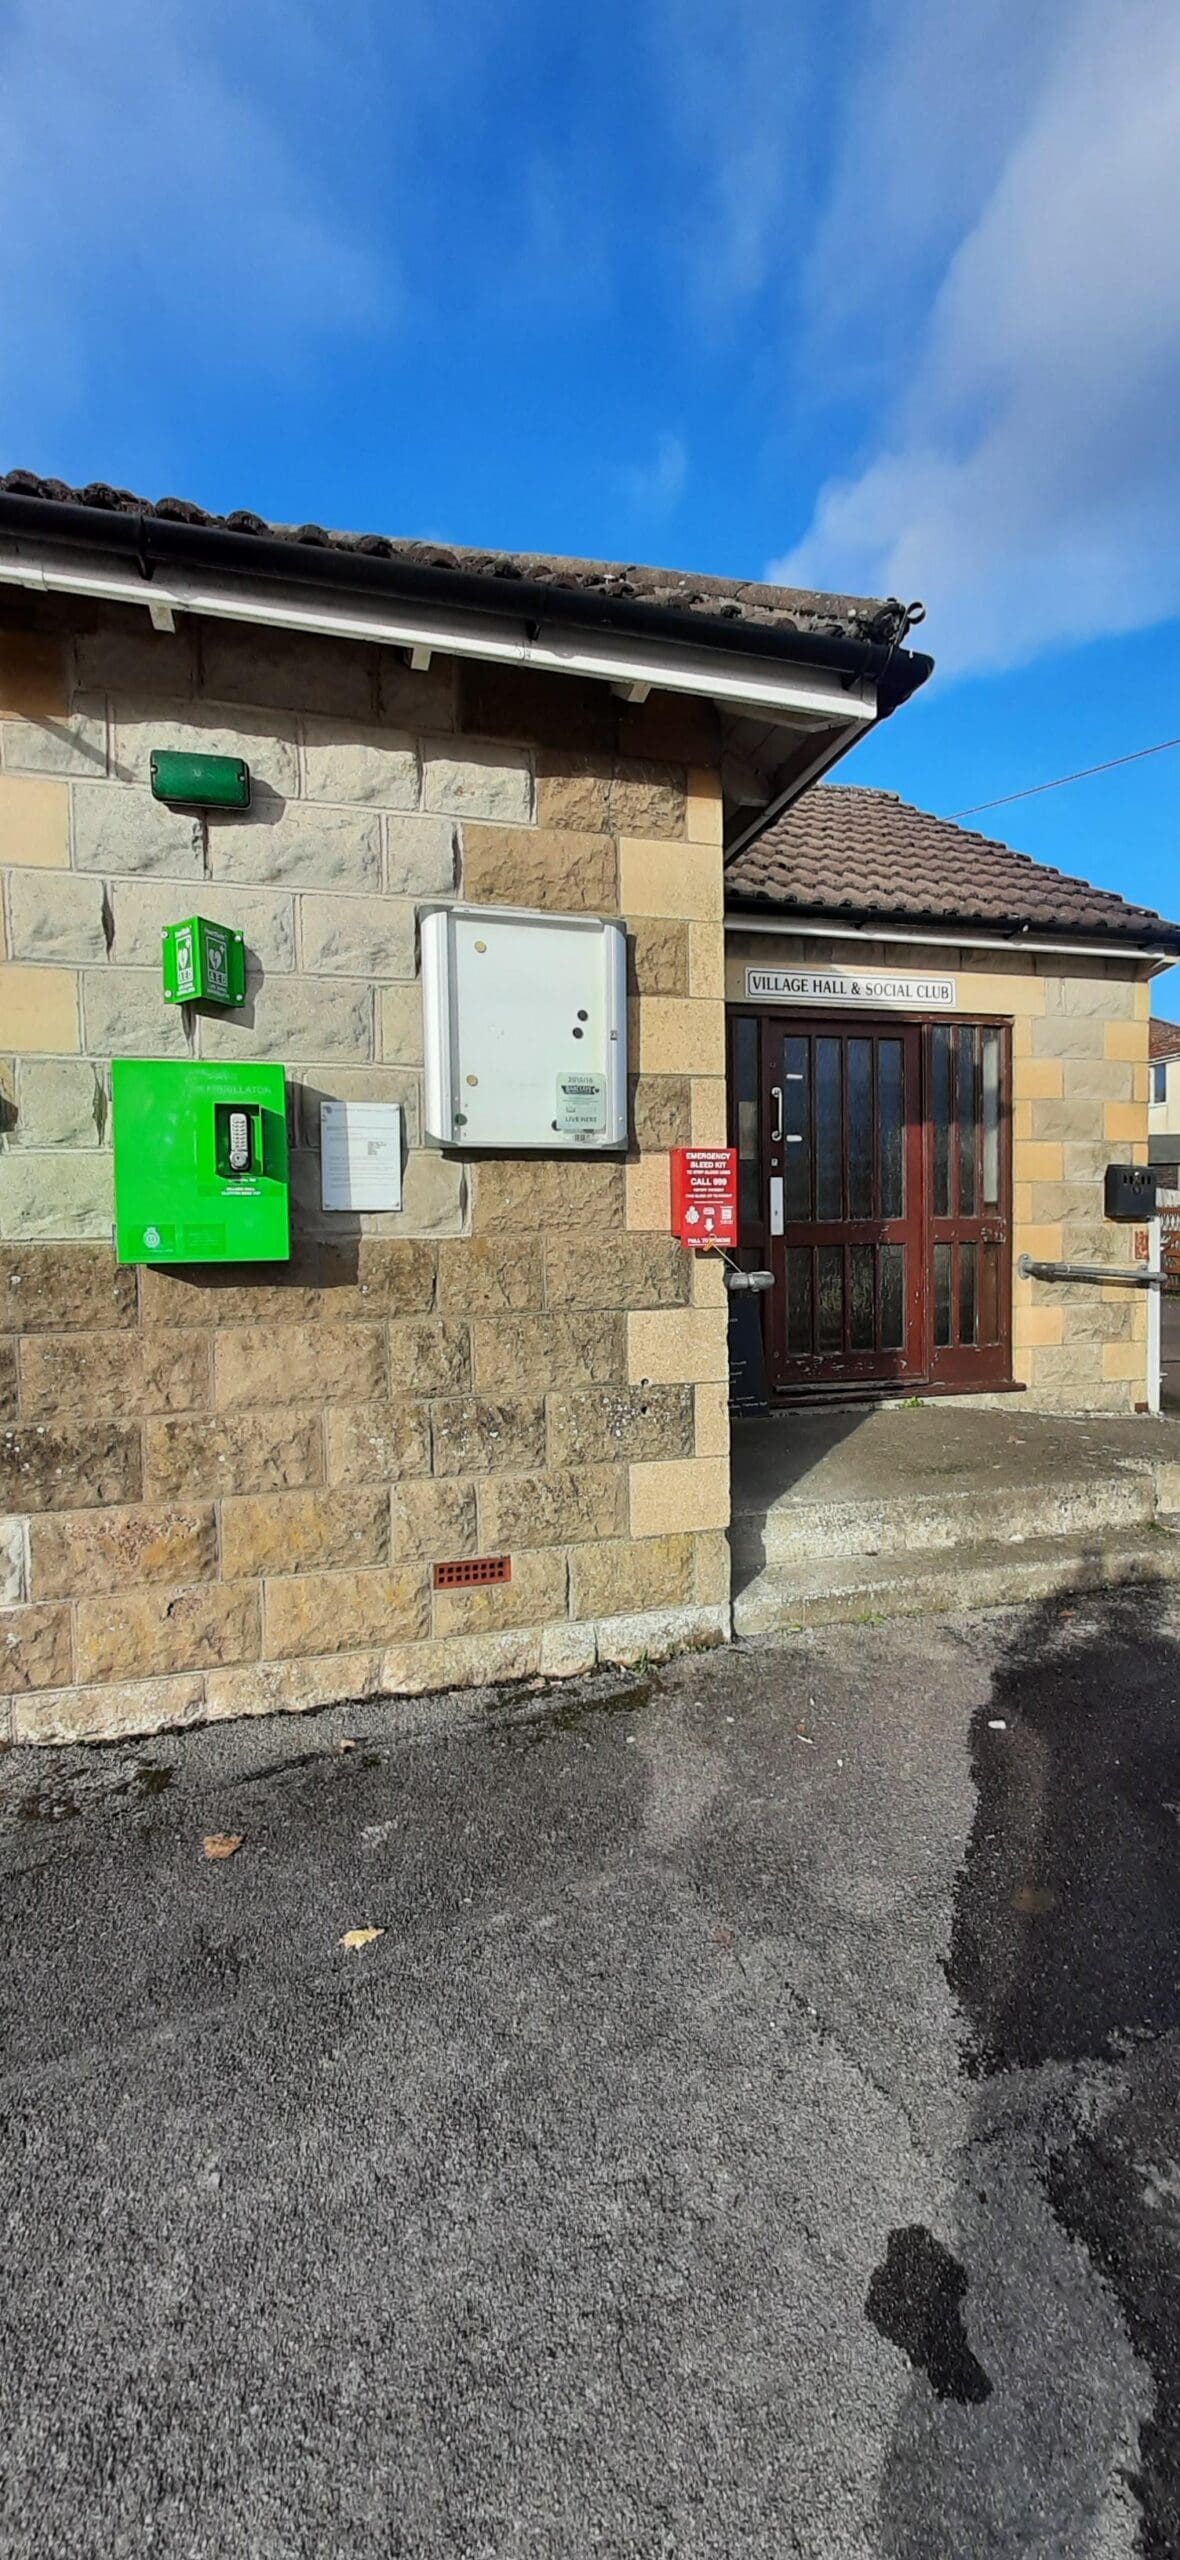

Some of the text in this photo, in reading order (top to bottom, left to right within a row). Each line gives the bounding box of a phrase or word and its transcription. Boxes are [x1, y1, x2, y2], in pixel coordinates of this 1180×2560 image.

[752, 976, 949, 999] VILLAGE HALL & SOCIAL CLUB
[686, 1152, 731, 1160] EMERGENCY
[690, 1161, 727, 1169] BLEED KIT
[690, 1177, 712, 1186] CALL
